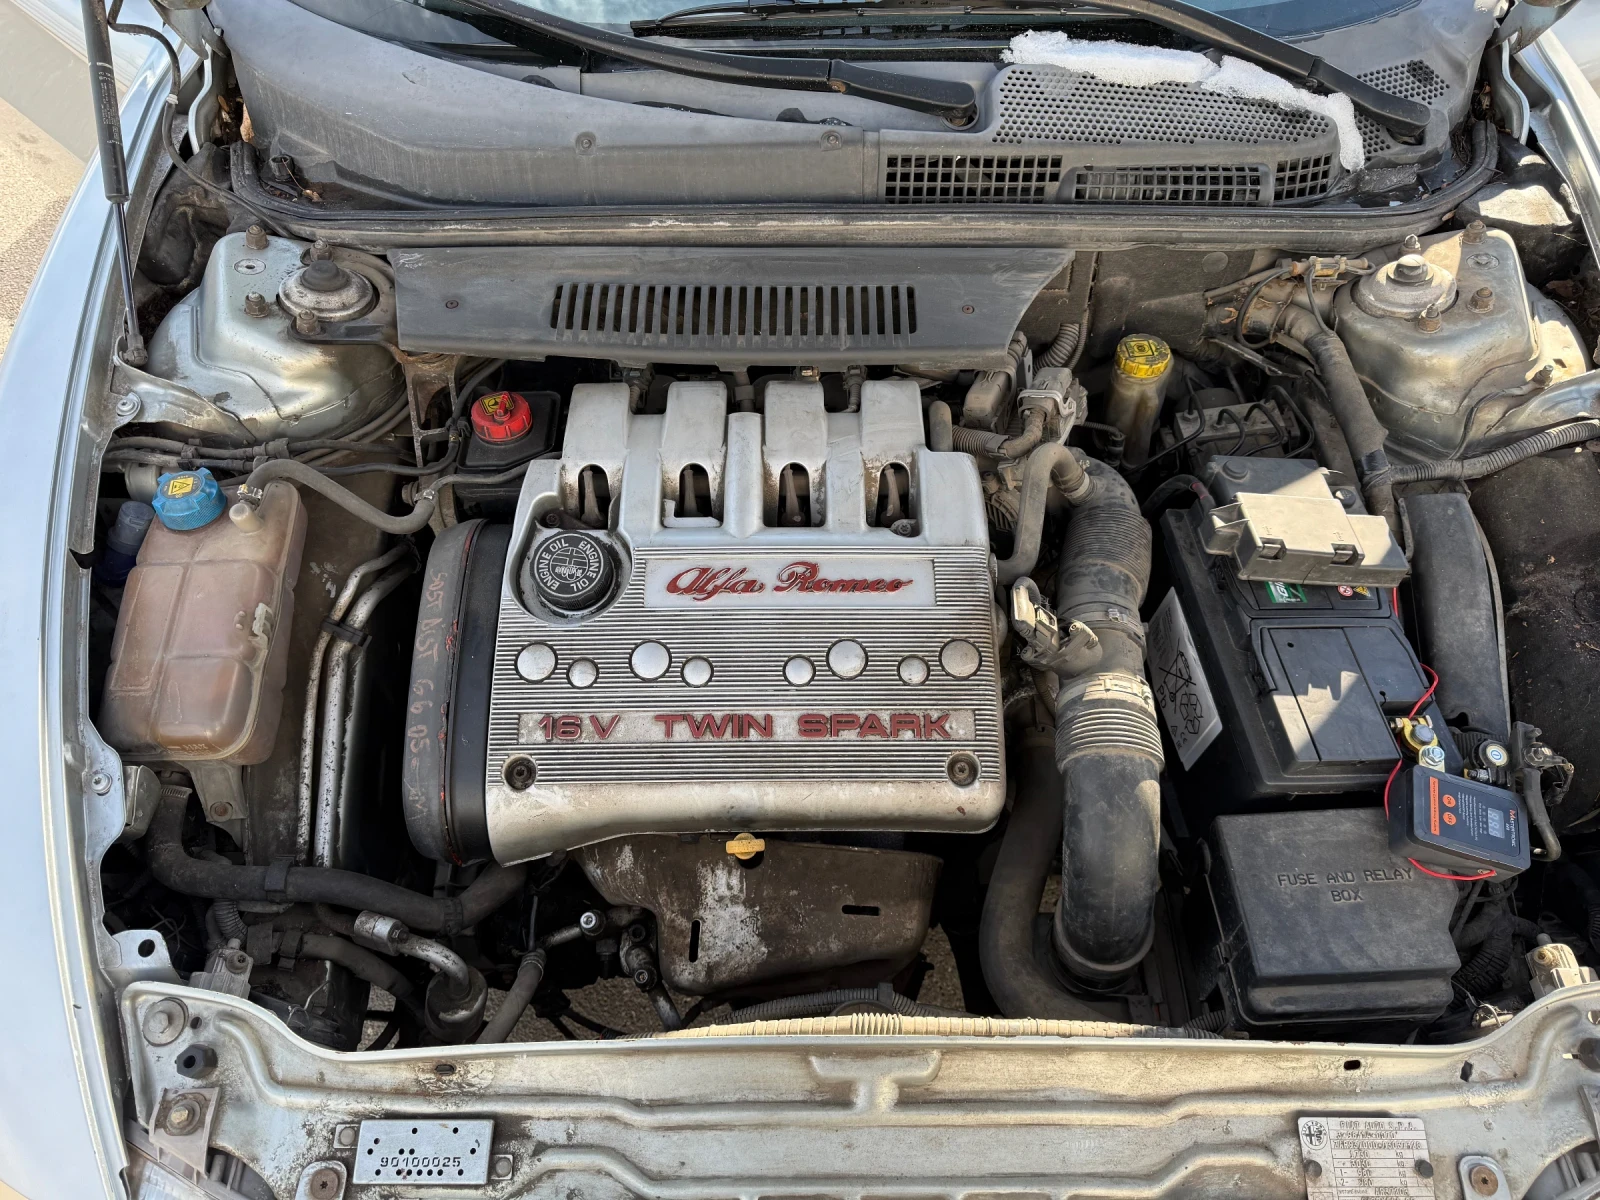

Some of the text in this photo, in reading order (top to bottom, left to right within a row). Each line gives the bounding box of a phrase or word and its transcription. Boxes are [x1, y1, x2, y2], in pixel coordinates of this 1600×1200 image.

[538, 551, 560, 591] ENGINE
[549, 538, 569, 552] OIL
[570, 540, 600, 592] ENGINE OIL
[666, 561, 914, 601] Alfa Romeo
[1156, 684, 1167, 710] Pb
[655, 713, 773, 739] TWIN
[799, 713, 951, 740] SPARK
[1277, 868, 1412, 887] FUSE AND RELAY
[1330, 889, 1363, 903] BOX
[379, 1156, 462, 1168] 90100025
